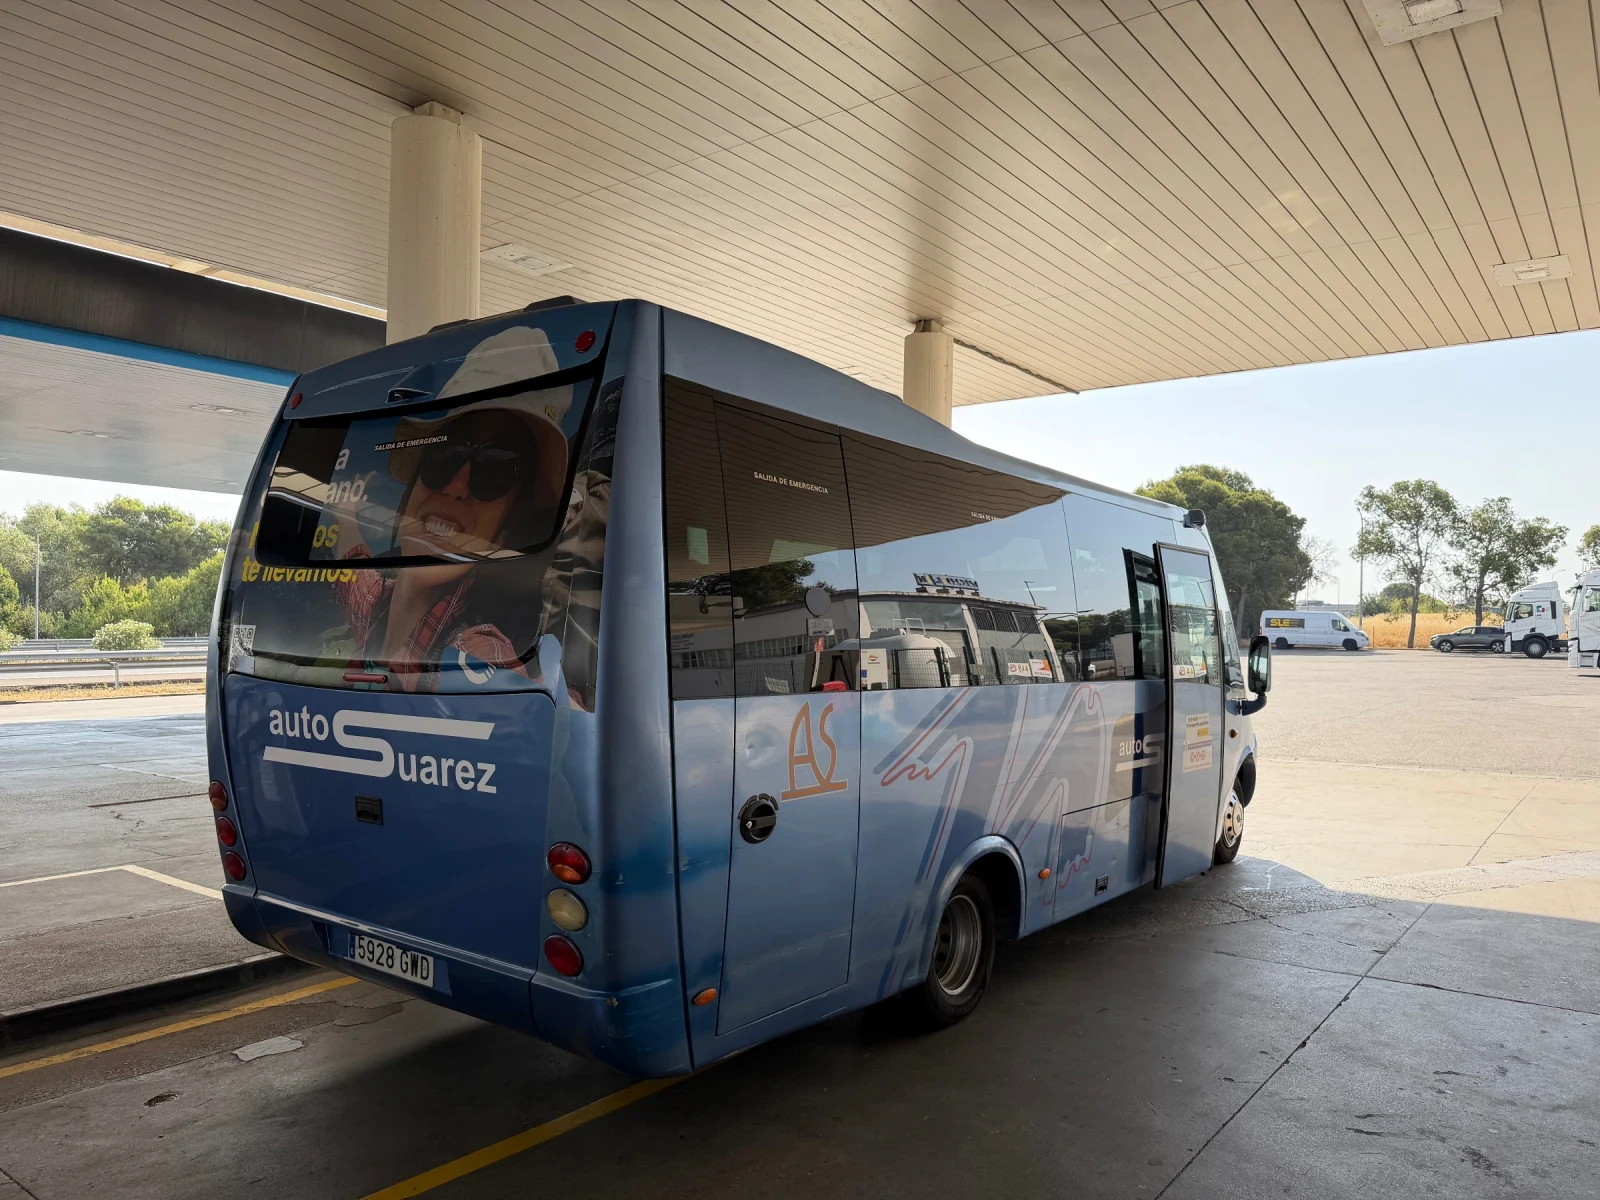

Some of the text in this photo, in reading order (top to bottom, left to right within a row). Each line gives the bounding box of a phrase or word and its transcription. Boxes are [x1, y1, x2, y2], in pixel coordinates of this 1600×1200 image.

[374, 443, 396, 452] SALIDA
[405, 435, 448, 447] EMERGENCIA
[753, 471, 829, 494] SALIDA DE EMERGENCIA
[241, 555, 261, 582] te
[1270, 618, 1290, 627] SLE
[269, 705, 329, 741] auto
[780, 700, 848, 802] AS
[1119, 737, 1142, 757] auto
[358, 936, 430, 981] 5928 GWD
